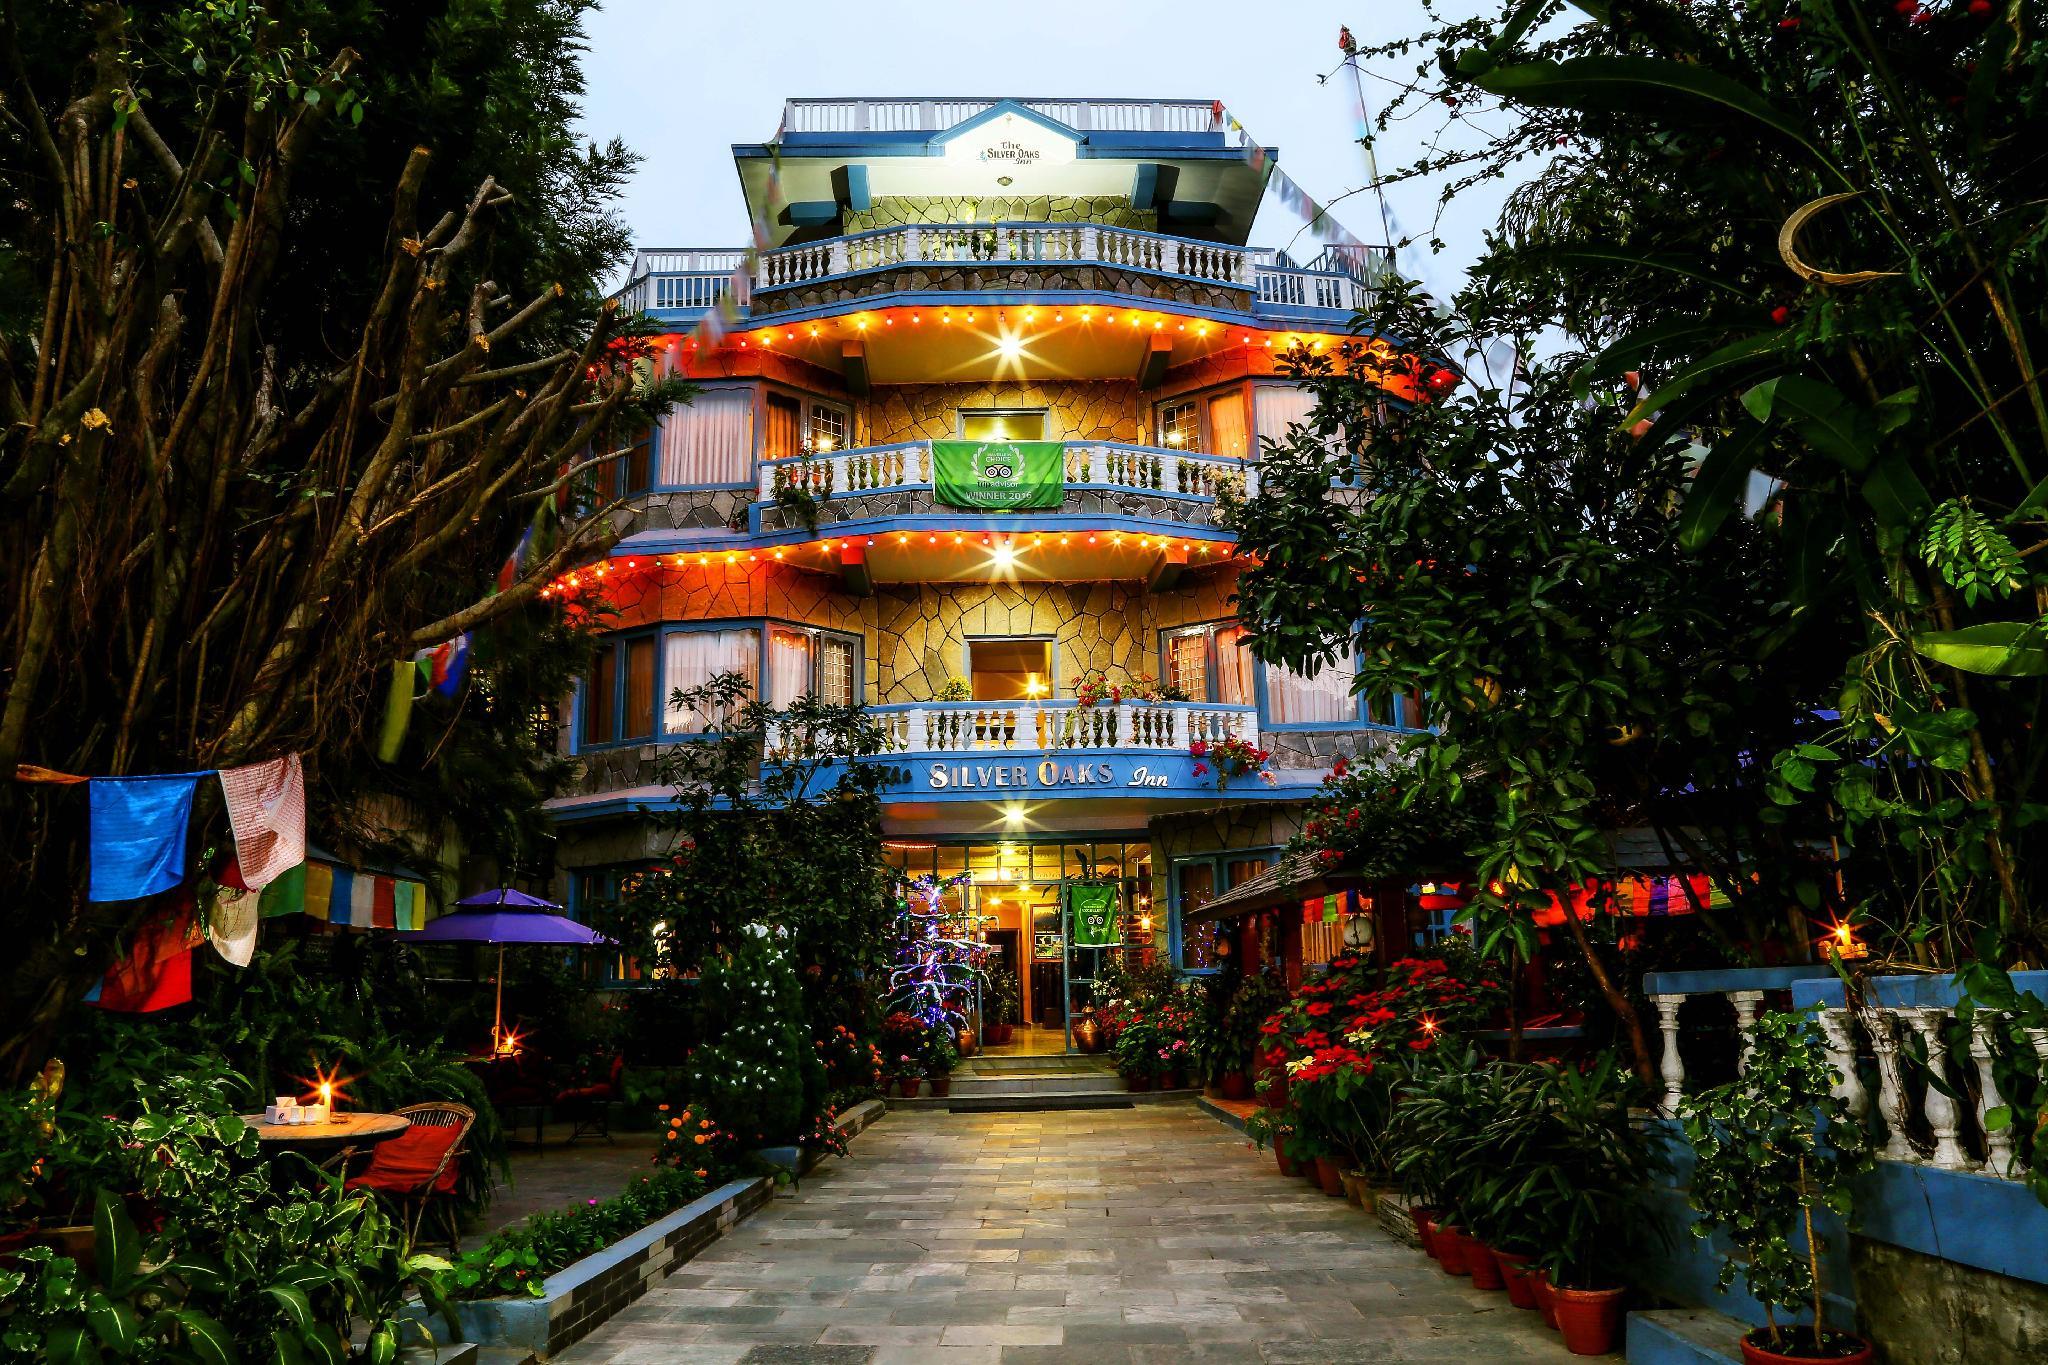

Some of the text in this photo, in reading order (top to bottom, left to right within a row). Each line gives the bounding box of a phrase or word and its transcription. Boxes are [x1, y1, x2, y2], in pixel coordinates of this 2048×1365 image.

[1000, 141, 1021, 150] The
[987, 148, 1040, 159] SILVER OAKS
[977, 480, 1019, 489] tripadvisor
[965, 491, 1006, 500] WINNER
[929, 763, 1027, 789] SILVER
[1037, 760, 1114, 787] OAKS
[1127, 766, 1169, 788] Inn
